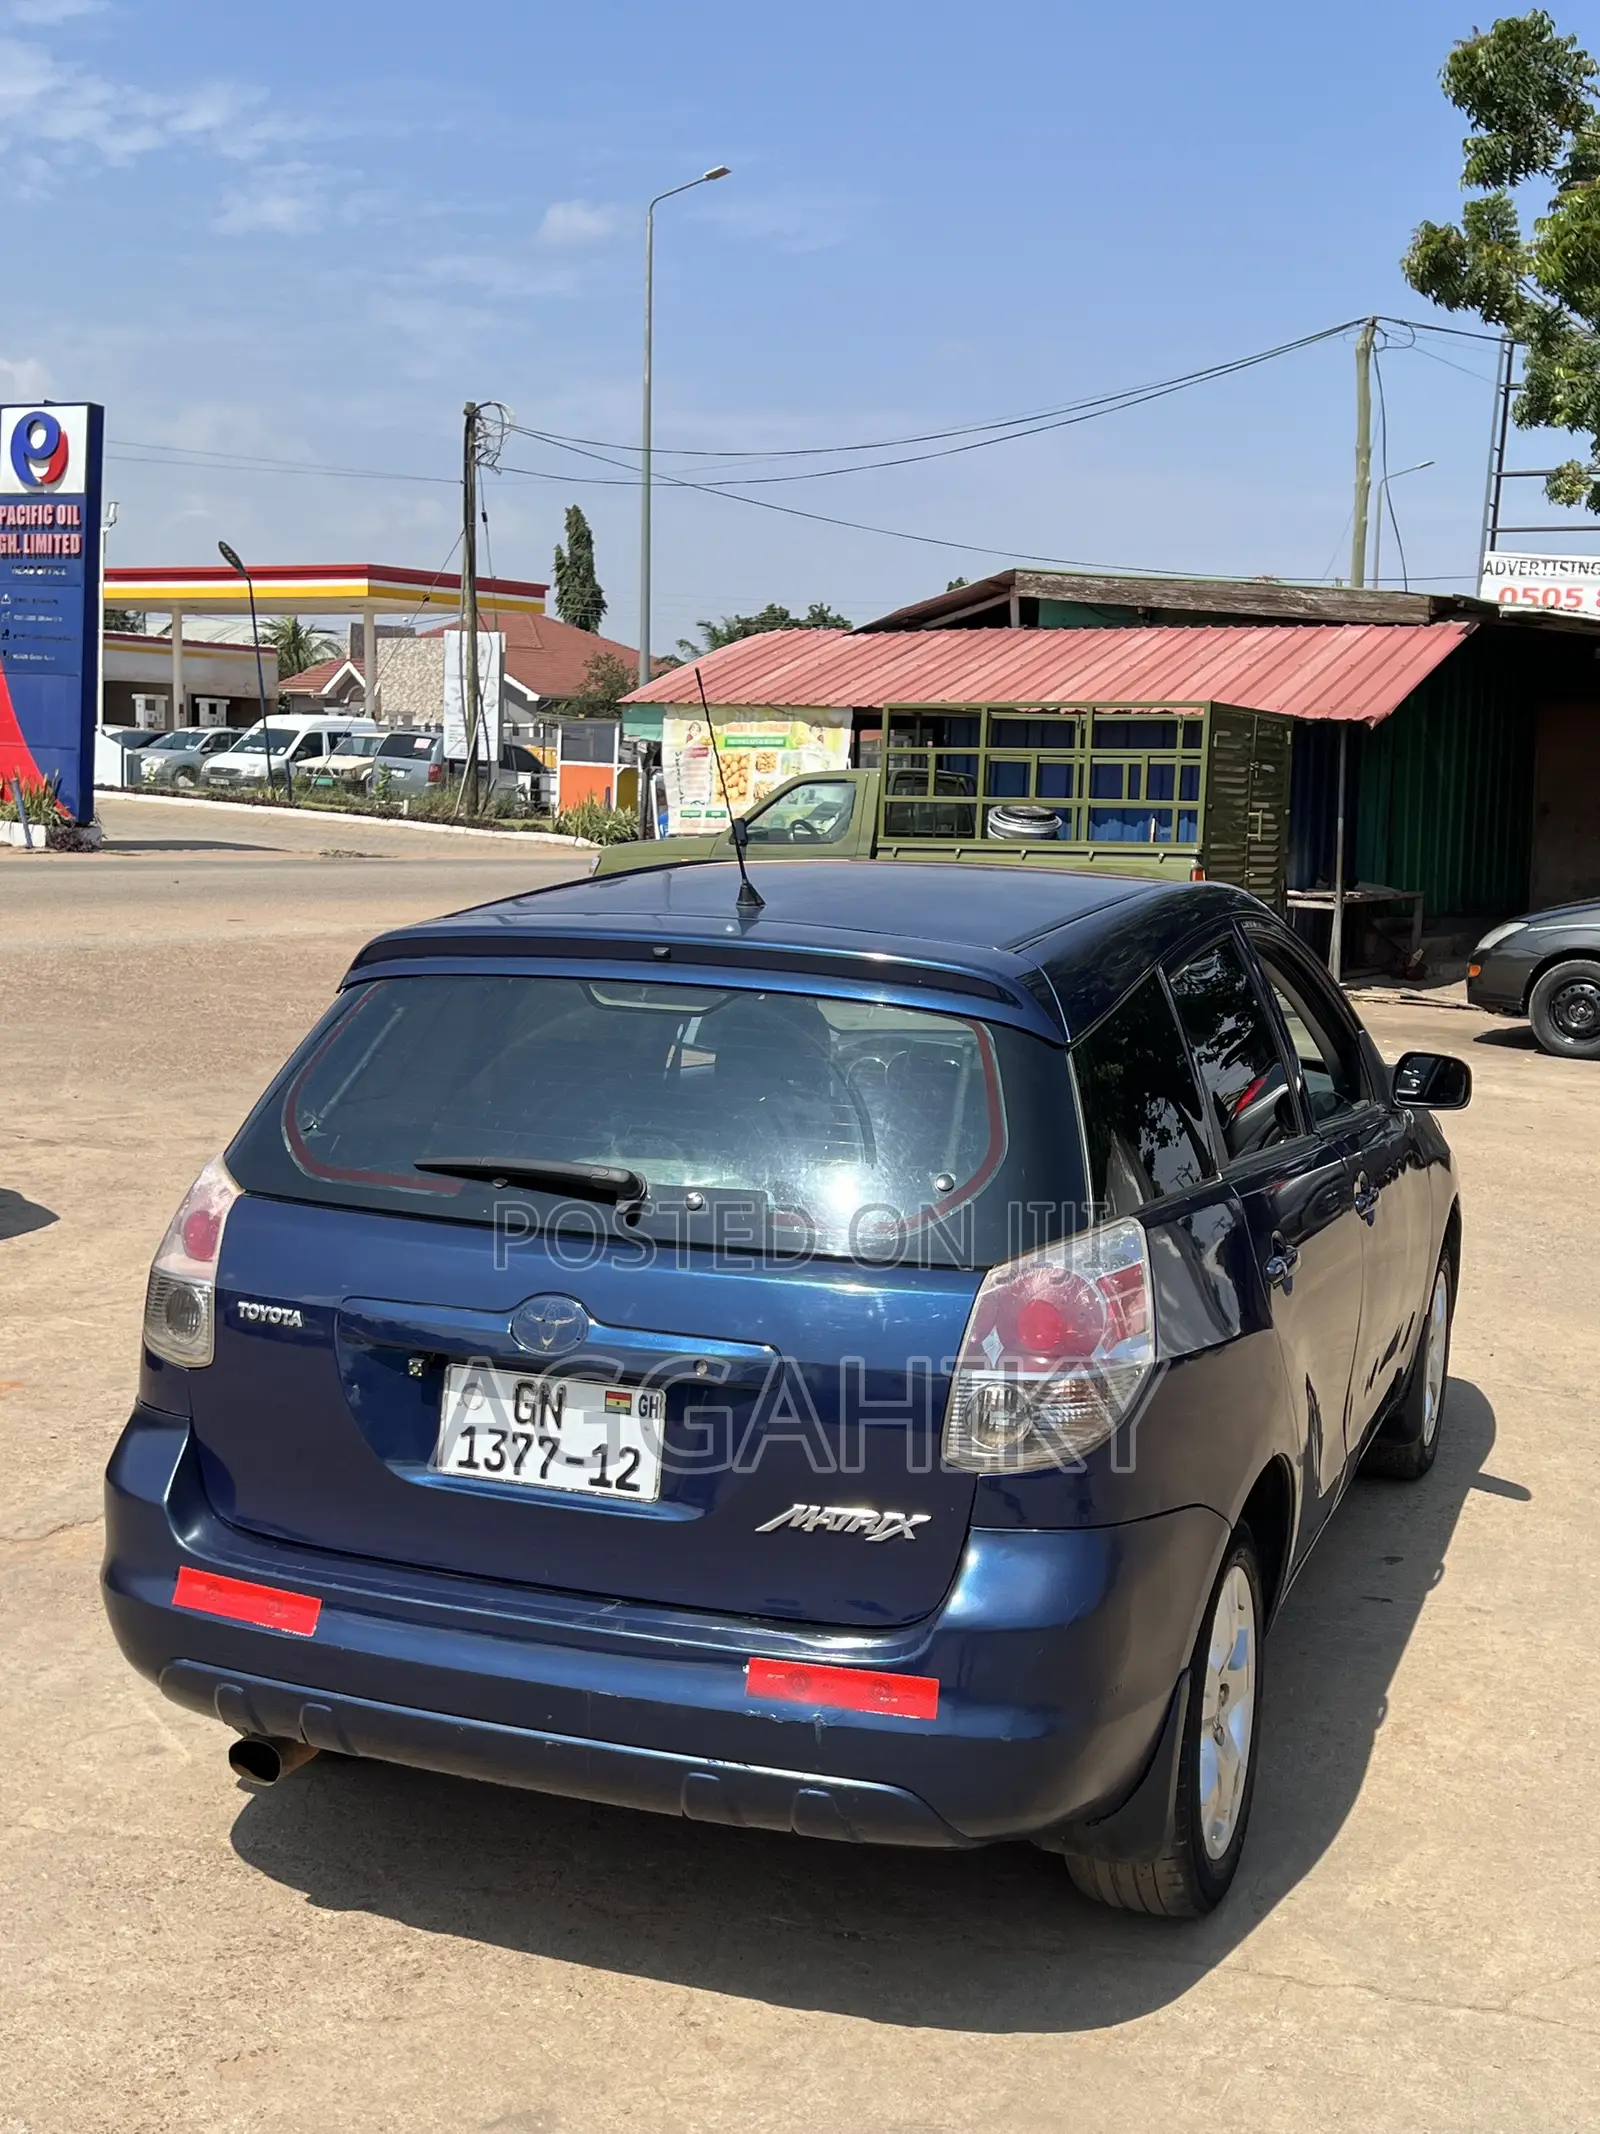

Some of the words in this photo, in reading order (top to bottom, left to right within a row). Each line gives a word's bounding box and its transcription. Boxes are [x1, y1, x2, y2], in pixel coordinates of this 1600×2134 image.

[0, 504, 54, 525] PACIFIC
[56, 504, 80, 525] OIL
[23, 533, 81, 554] LIMITED
[1483, 560, 1600, 577] ADVERTISING
[1499, 587, 1583, 609] 0505
[237, 1301, 303, 1328] TOYOTA
[513, 1379, 566, 1430] GN
[638, 1394, 660, 1419] GH
[456, 1425, 641, 1492] 1377-12
[755, 1503, 932, 1542] MATRIX
